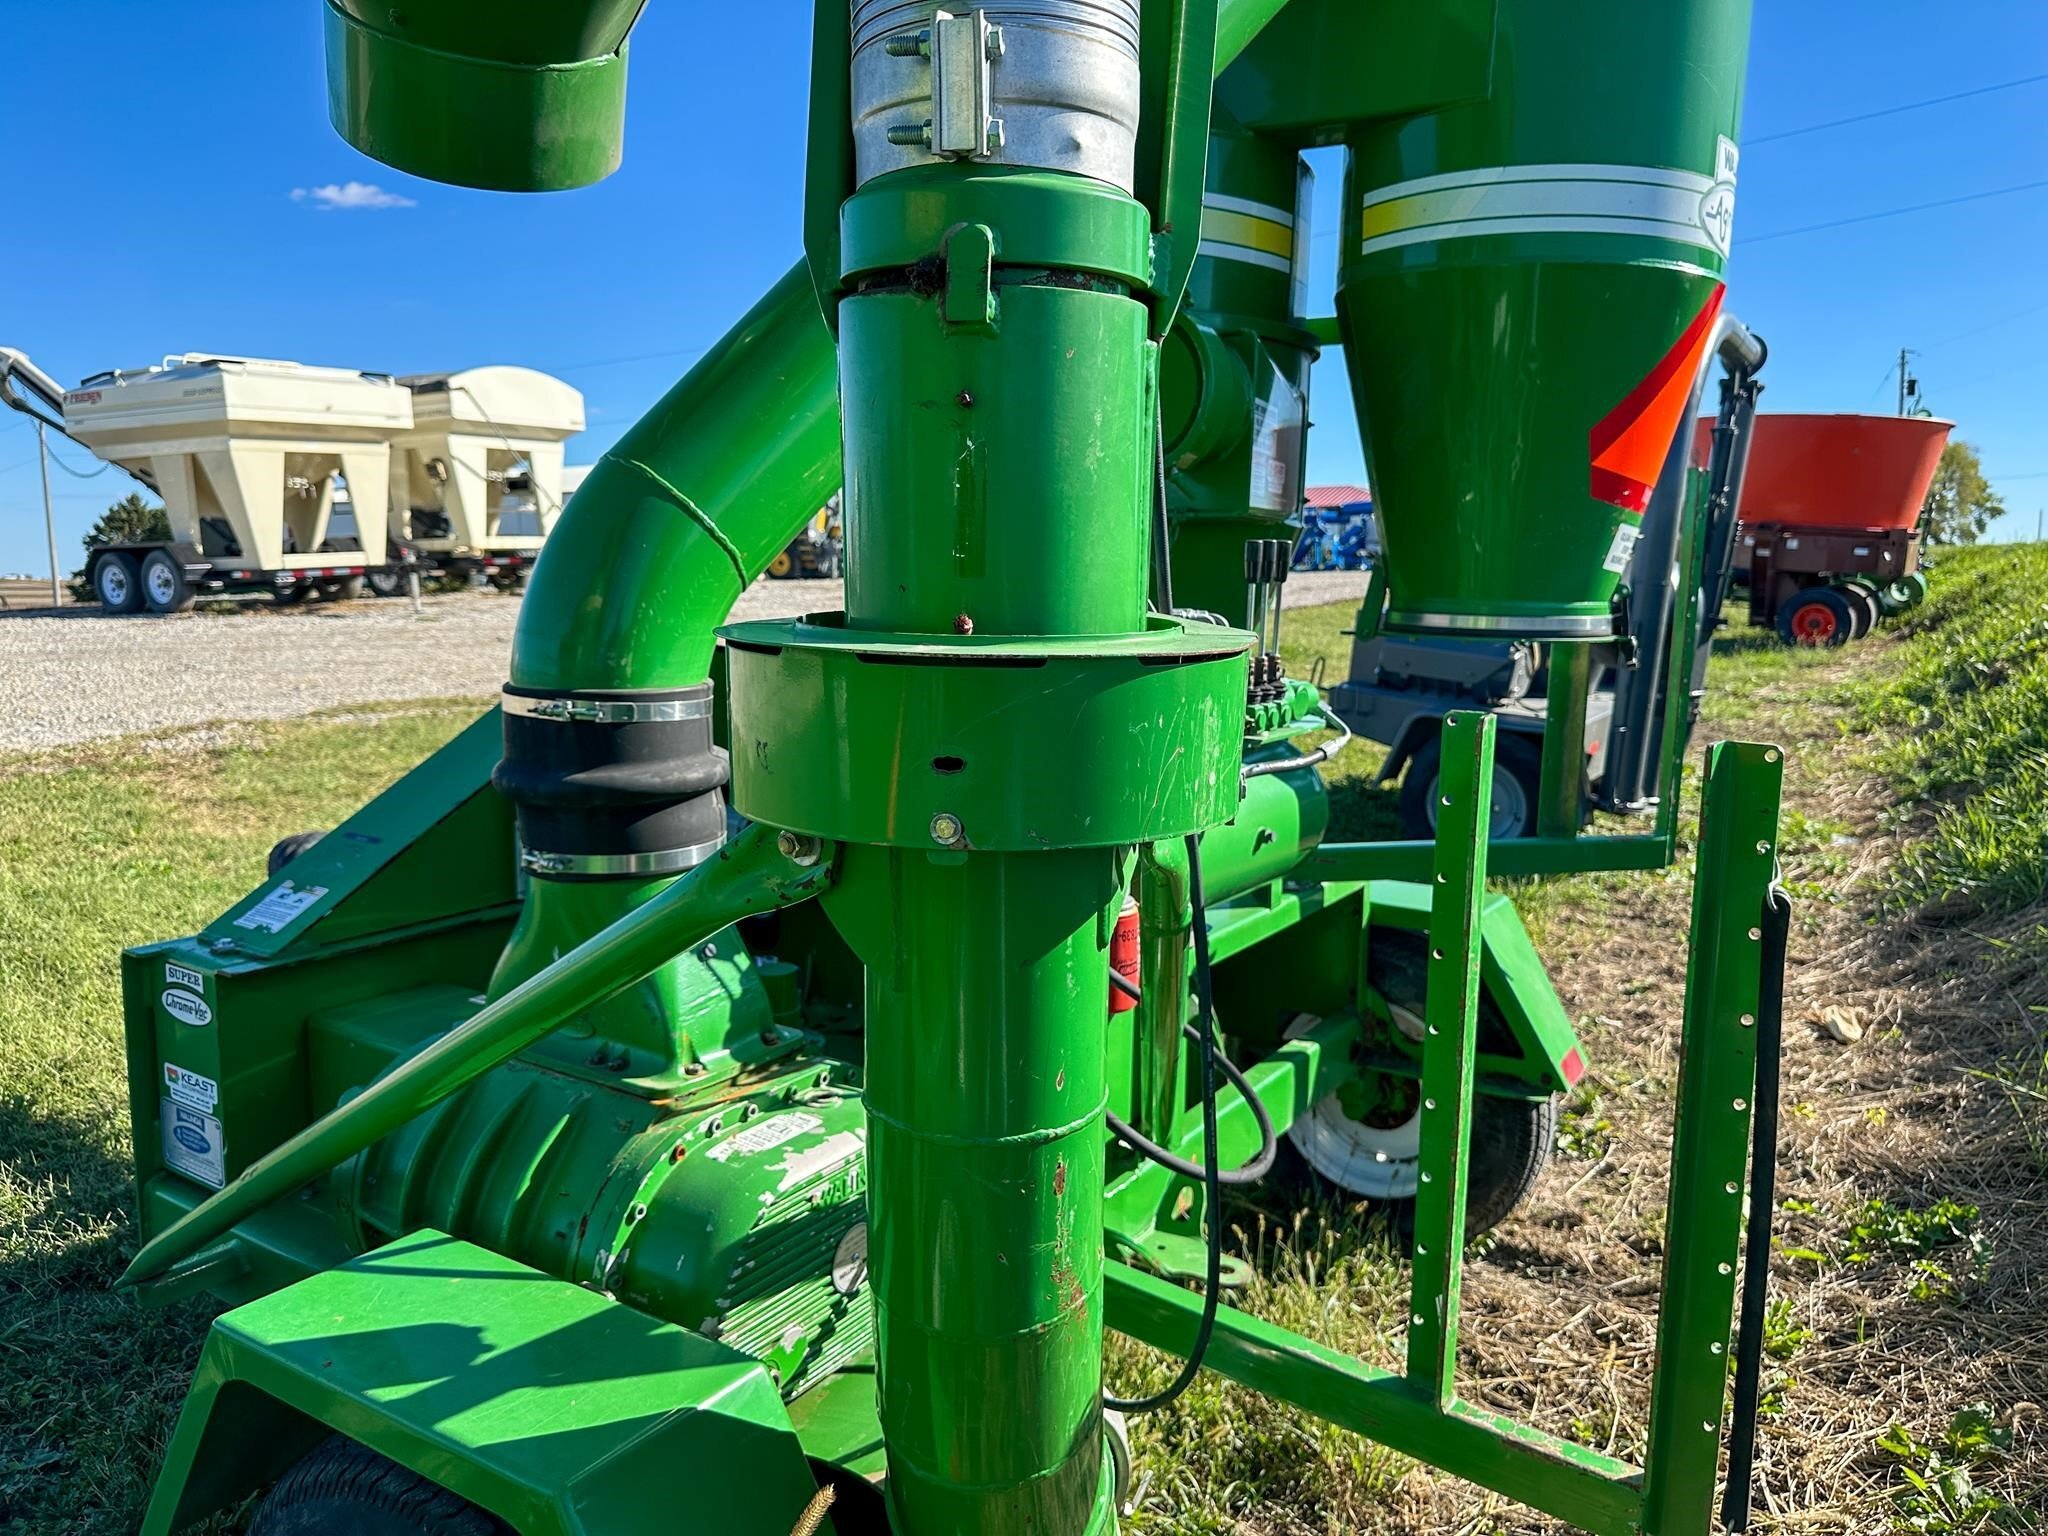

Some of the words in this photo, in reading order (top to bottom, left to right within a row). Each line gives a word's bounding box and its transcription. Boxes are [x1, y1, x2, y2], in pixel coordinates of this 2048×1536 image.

[168, 966, 201, 987] SUPER
[165, 992, 208, 1020] Chrome-Vac
[181, 1071, 216, 1094] KEAST
